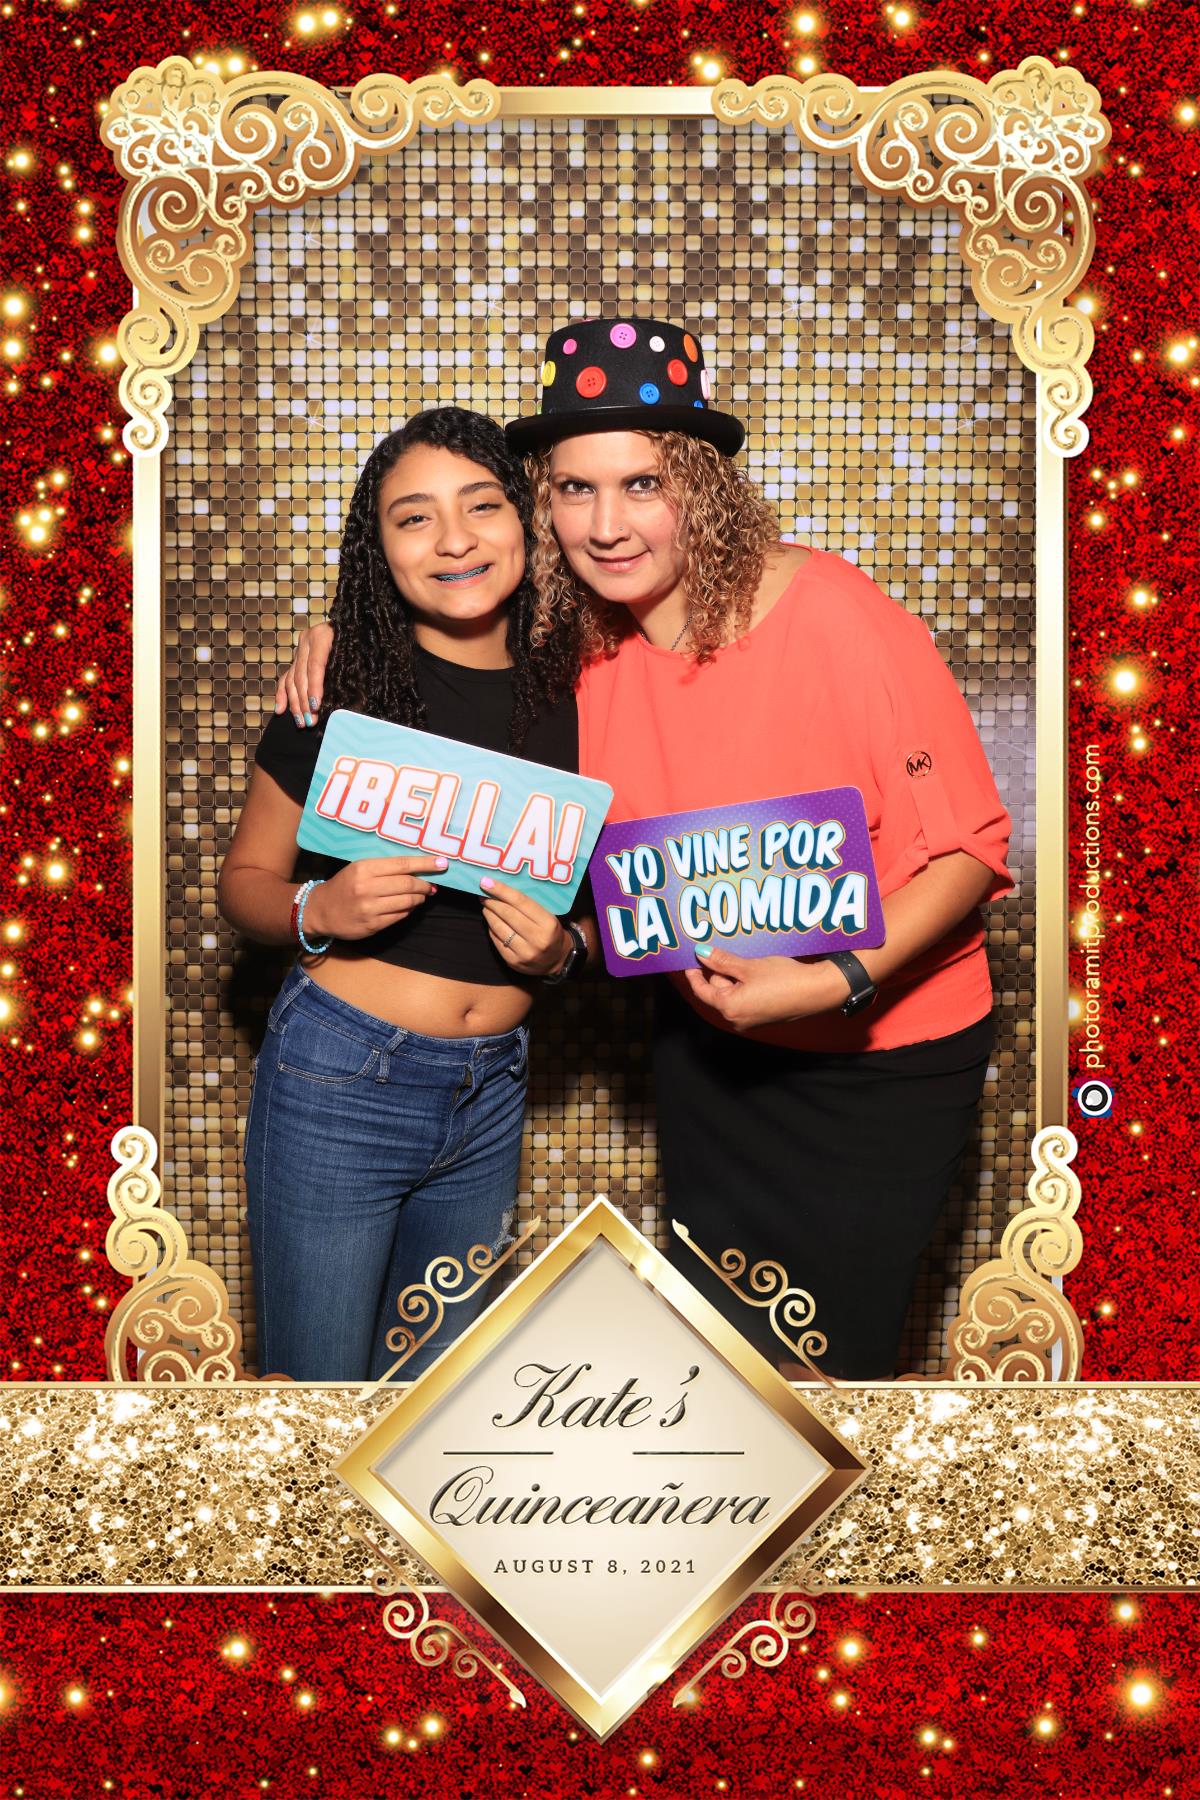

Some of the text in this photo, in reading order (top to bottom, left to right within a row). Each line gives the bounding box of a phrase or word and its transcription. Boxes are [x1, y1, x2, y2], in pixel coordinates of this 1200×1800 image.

[908, 754, 931, 775] MK
[315, 756, 586, 885] ¡BELLA!
[605, 820, 846, 896] YO VINE POR
[606, 872, 868, 959] LA COMIDA
